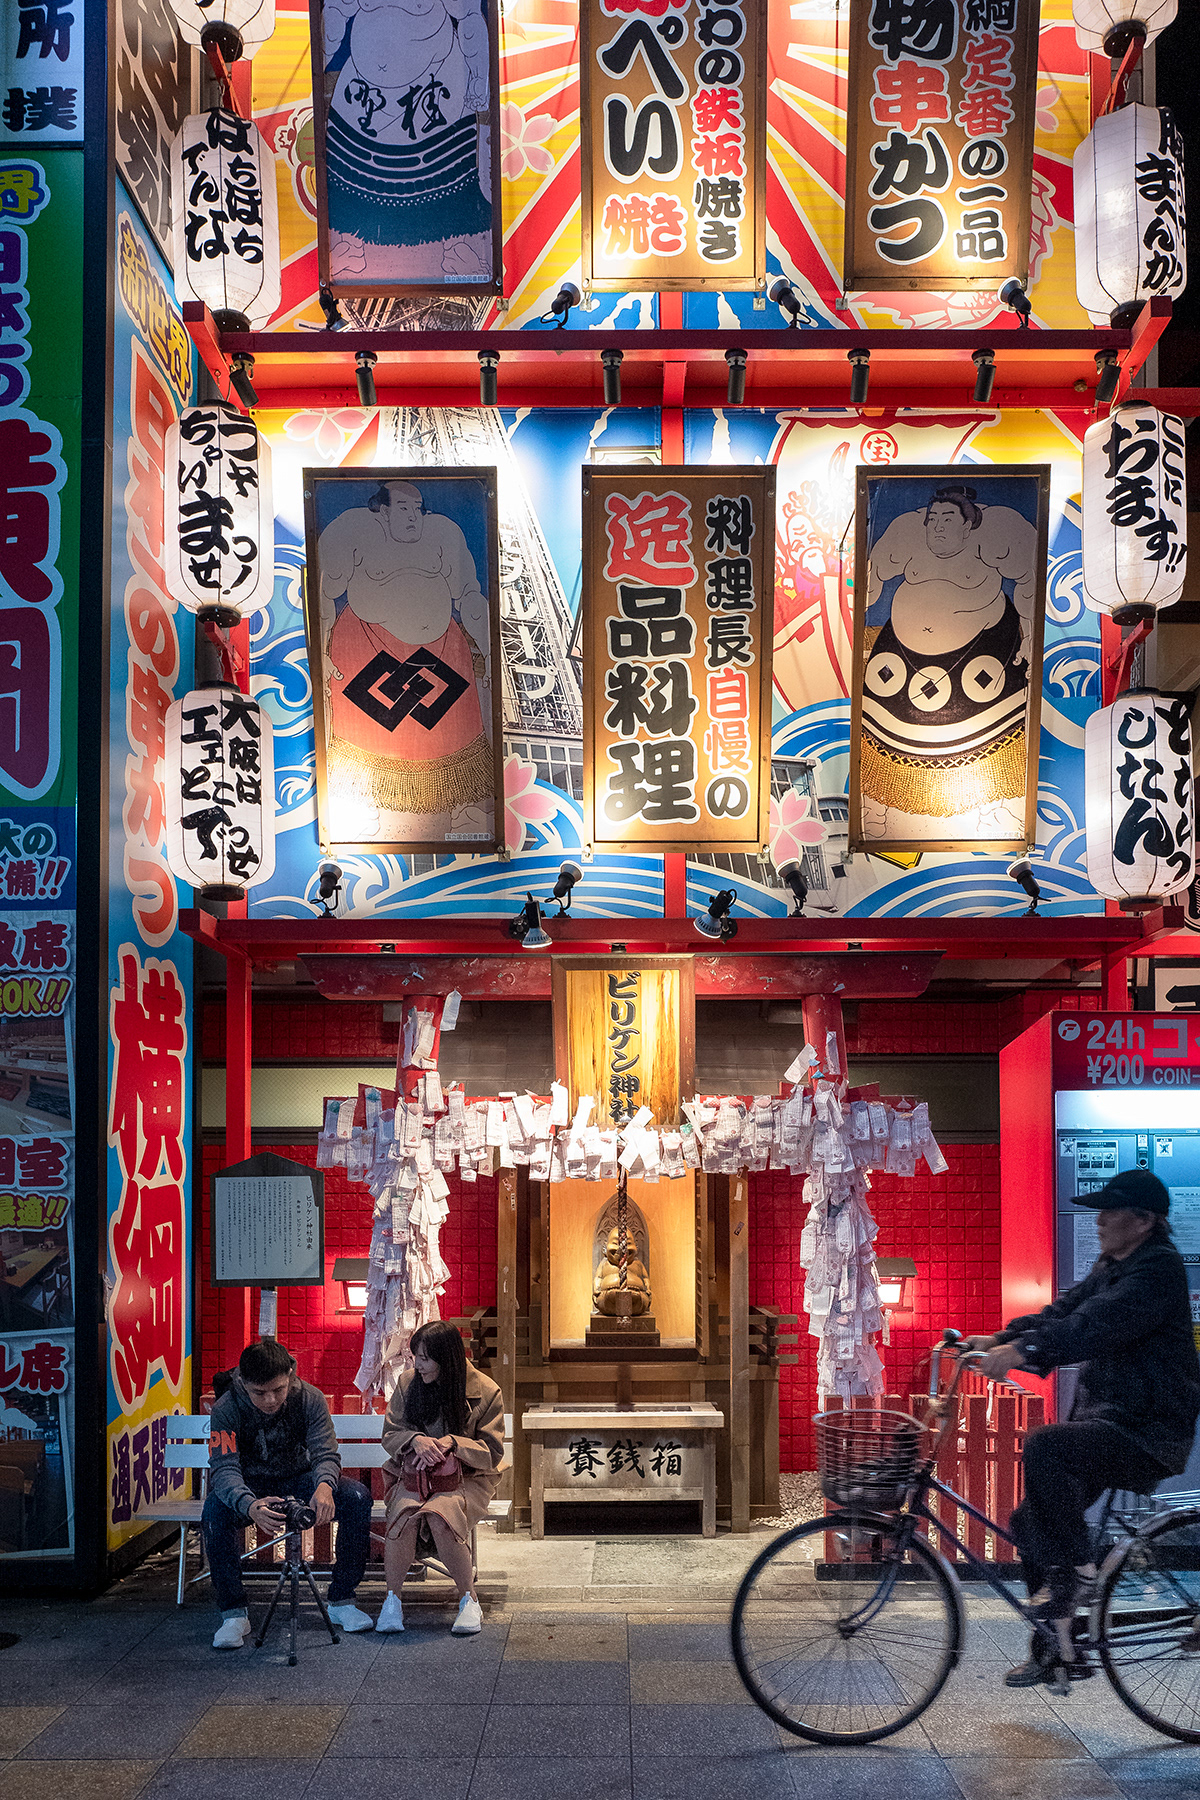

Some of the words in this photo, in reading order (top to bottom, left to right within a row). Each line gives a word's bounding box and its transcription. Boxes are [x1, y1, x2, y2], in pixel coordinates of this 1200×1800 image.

[16, 0, 75, 62] 所
[601, 0, 686, 254] ぺい焼き
[694, 0, 743, 260] わの鉄板焼き
[182, 142, 229, 262] でんな
[121, 219, 190, 402] 新世界
[605, 495, 696, 820] 逸品料理
[706, 497, 755, 817] 料理長自慢の
[219, 693, 261, 805] 大阪は
[0, 860, 68, 896] 備!!
[608, 971, 640, 1122] ビリケン神社
[1087, 1020, 1145, 1049] 24h
[1153, 1019, 1200, 1058] コ
[1087, 1055, 1145, 1085] ¥200
[113, 954, 184, 1404] 横綱
[565, 1437, 682, 1479] 賽銭箱
